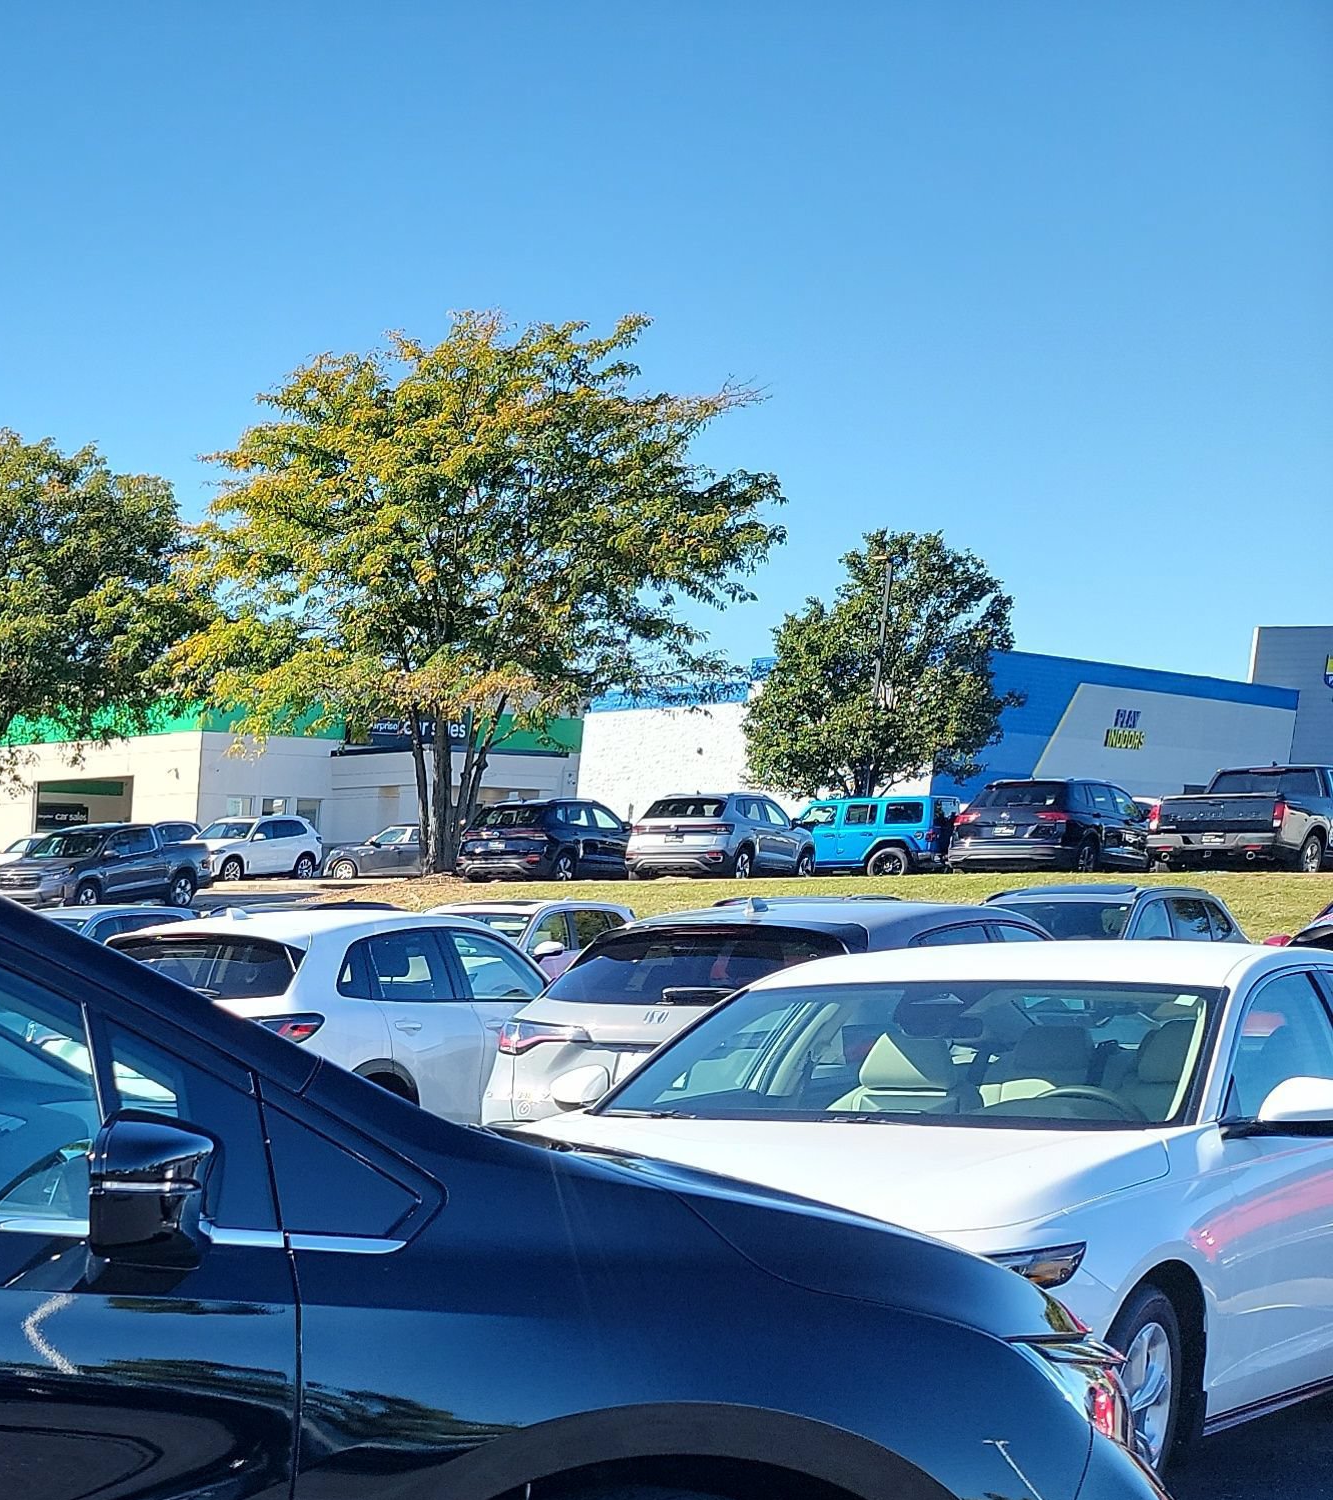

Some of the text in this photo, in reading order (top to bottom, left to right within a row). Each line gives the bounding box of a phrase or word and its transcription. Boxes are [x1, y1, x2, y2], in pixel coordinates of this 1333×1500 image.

[1114, 708, 1142, 728] PLAY
[403, 720, 430, 737] cr
[431, 720, 467, 738] sles
[1103, 728, 1145, 750] INDOORS
[55, 812, 69, 821] car
[69, 811, 87, 821] sales
